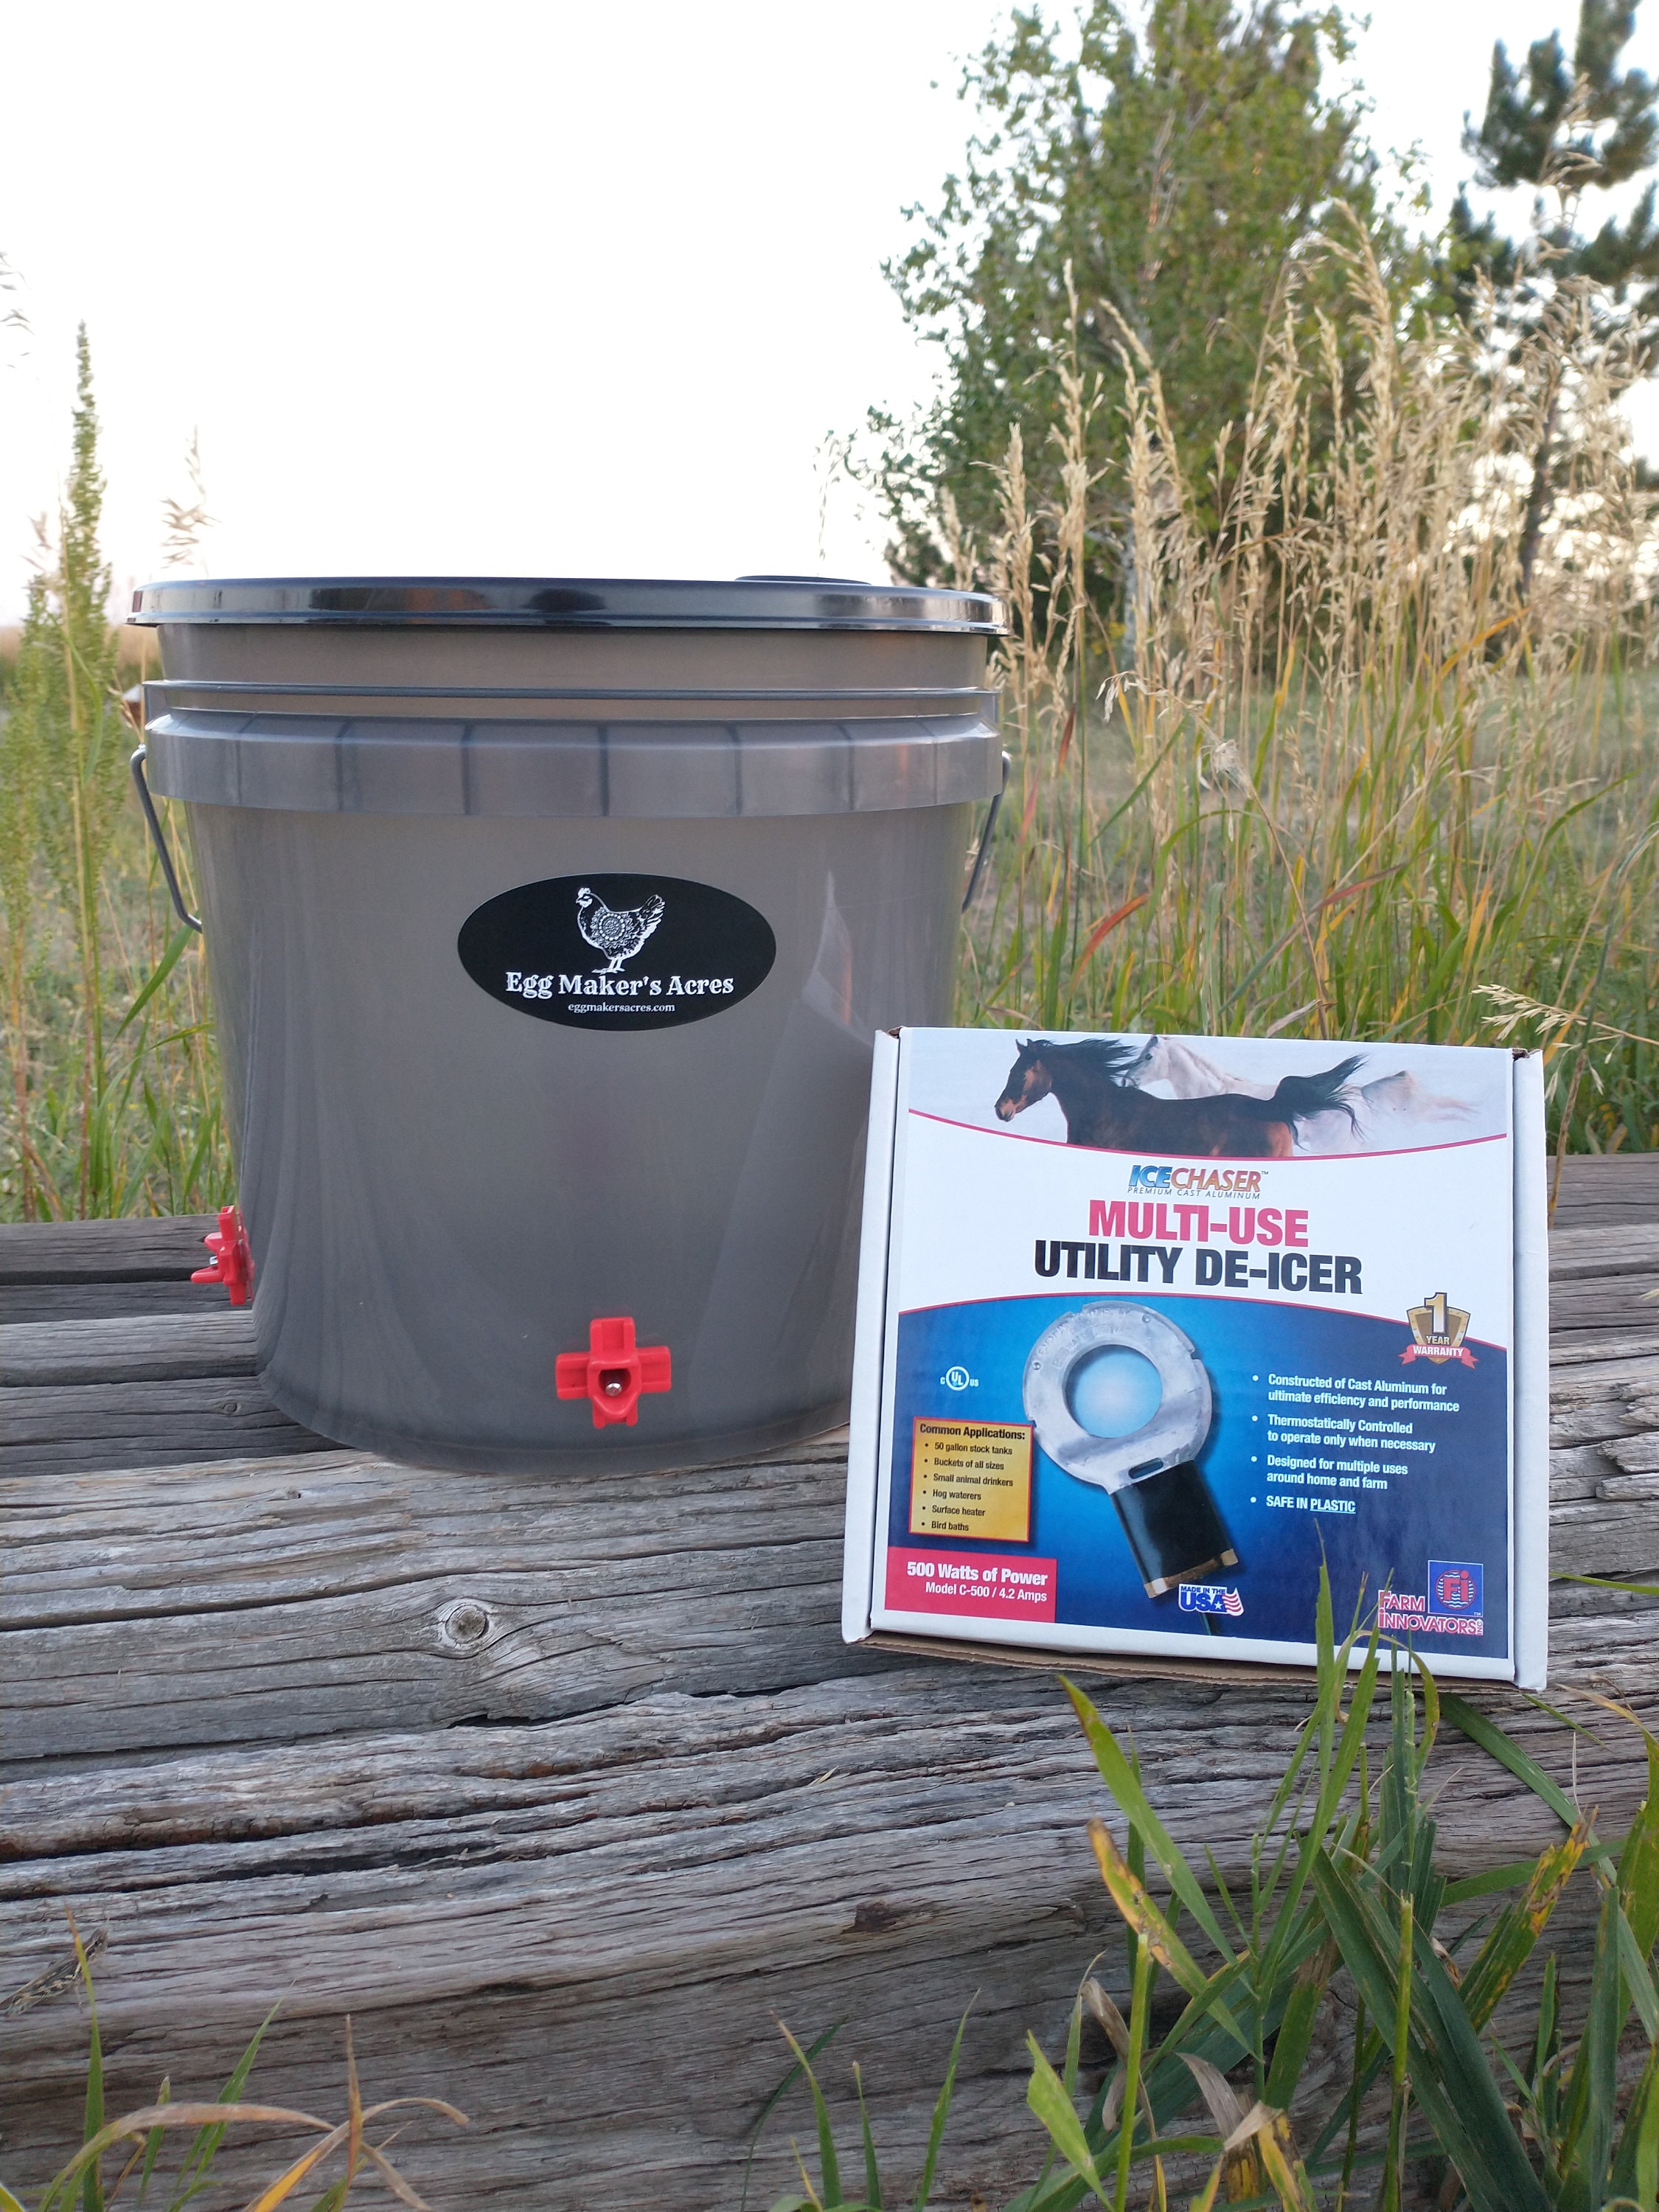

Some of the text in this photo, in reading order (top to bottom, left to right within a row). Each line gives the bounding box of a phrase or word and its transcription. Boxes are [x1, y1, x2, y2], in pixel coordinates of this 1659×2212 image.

[505, 971, 734, 999] Egg Maker's Acres
[568, 1002, 675, 1014] eggmakersacres.com
[1127, 1187, 1172, 1195] PREMIUM
[1205, 1191, 1260, 1200] ALUMINUM
[1088, 1199, 1309, 1248] MULTI-USE
[1034, 1239, 1363, 1295] UTILITY DE-ICER
[1424, 1292, 1447, 1335] 1
[1425, 1335, 1450, 1345] YEAR
[1413, 1346, 1464, 1357] WARRANTY
[1268, 1374, 1447, 1396] Constructed of Cast Aluminum for
[1268, 1391, 1460, 1413] ultimate efficiency and performance
[919, 1423, 1026, 1440] Common Applications:
[1267, 1413, 1413, 1434] Thermostatically Controlled
[934, 1442, 1013, 1455] 50 gallon stock tanks
[1267, 1430, 1436, 1453] to operate only when necessary
[933, 1458, 1004, 1470] Buckets of all sizes
[1267, 1455, 1408, 1475] Designed for multiple uses
[933, 1473, 1014, 1486] Small animal drinkers
[1267, 1472, 1388, 1489] around home and farm
[933, 1489, 981, 1500] Hog waterers
[1266, 1495, 1356, 1512] SAFE IN PLASTIC
[932, 1505, 986, 1516] Surface heater
[931, 1520, 969, 1531] Bird baths
[907, 1561, 1048, 1585] 500 Watts of Power
[925, 1582, 1047, 1602] Model C-500 / 4.2 Amps
[1378, 1590, 1425, 1612] FARM
[1180, 1591, 1228, 1613] USA
